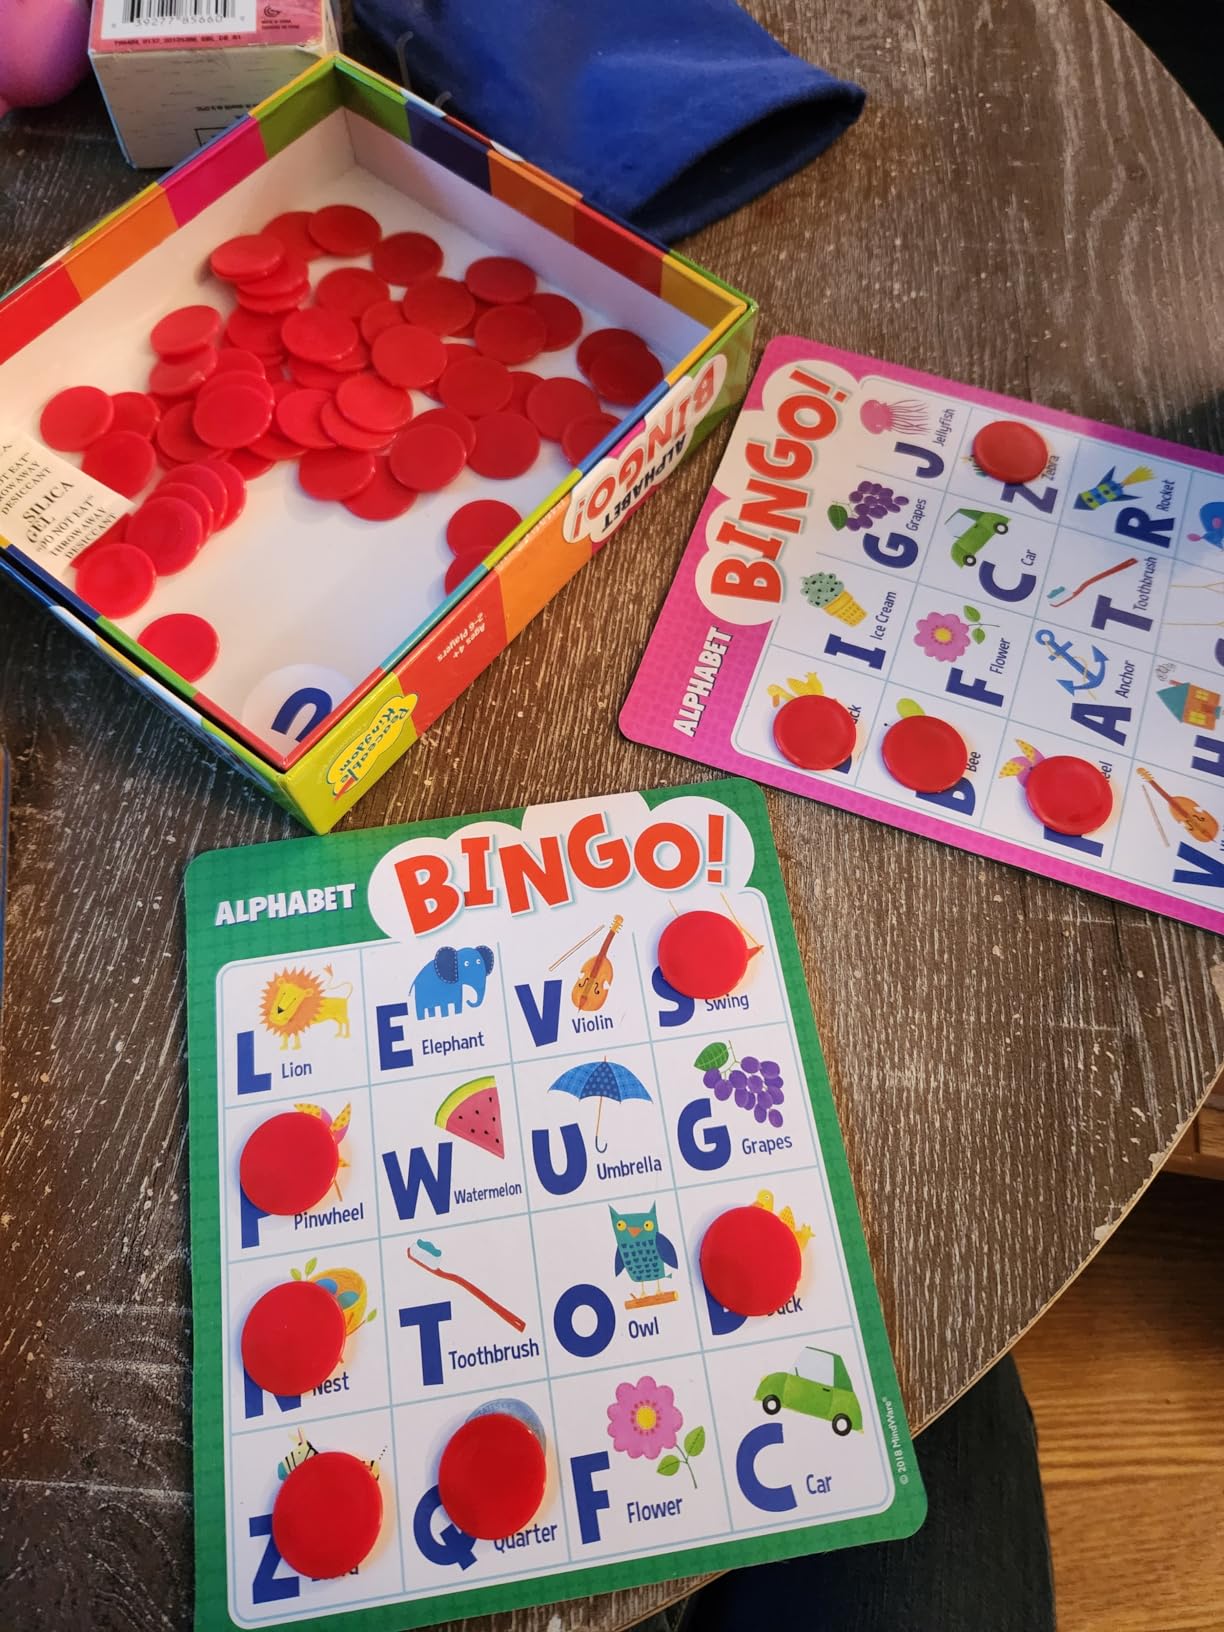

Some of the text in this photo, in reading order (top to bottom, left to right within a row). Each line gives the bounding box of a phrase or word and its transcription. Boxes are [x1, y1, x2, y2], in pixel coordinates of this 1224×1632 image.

[932, 408, 955, 447] Jellyfish
[573, 362, 714, 539] BINGO!
[894, 442, 945, 478] J
[23, 481, 74, 523] SILICA
[602, 433, 686, 532] ALPHABET
[711, 369, 847, 603] BINGO!
[1156, 479, 1176, 512] Rocket
[26, 516, 56, 544] GEL
[50, 507, 107, 556] THROW AWAY
[53, 516, 73, 536] NOT
[906, 498, 927, 532] Grapes
[1114, 507, 1175, 549] R
[64, 513, 117, 559] DESICCANT
[863, 532, 919, 569] G
[1021, 548, 1037, 567] Car
[979, 560, 1037, 603] C
[1133, 556, 1158, 611] Toothbrush
[869, 591, 897, 641] Ice Cream
[1091, 594, 1153, 632] T
[437, 627, 468, 663] Players
[453, 623, 486, 658] Ages 4+
[824, 633, 887, 670] I
[989, 637, 1011, 674] Flower
[673, 626, 733, 737] ALPHABET
[945, 666, 1004, 707] F
[1114, 659, 1136, 699] Anchor
[339, 707, 395, 772] Kingdom
[1070, 702, 1132, 746] A
[340, 707, 409, 783] Peaceable
[215, 813, 724, 935] ALPHABET BINGO!
[514, 979, 562, 1048] V
[705, 993, 750, 1013] Swing
[376, 1002, 414, 1071] E
[422, 1031, 485, 1056] Elephant
[572, 1015, 614, 1034] Violin
[237, 1030, 272, 1095] L
[281, 1061, 313, 1079] Lion
[677, 1098, 731, 1171] G
[742, 1135, 793, 1157] Grapes
[532, 1123, 588, 1196] U
[596, 1156, 662, 1181] Umbrella
[381, 1142, 453, 1220] W
[453, 1182, 523, 1204] Watermelon
[294, 1203, 365, 1230] Pinwheel
[553, 1283, 616, 1358] O
[628, 1316, 660, 1339] Owl
[398, 1301, 452, 1386] T
[448, 1338, 540, 1370] Toothbrush
[736, 1422, 798, 1513] C
[894, 1449, 908, 1474] 2018
[570, 1451, 610, 1545] F
[806, 1473, 832, 1495] Car
[627, 1497, 683, 1524] Flower
